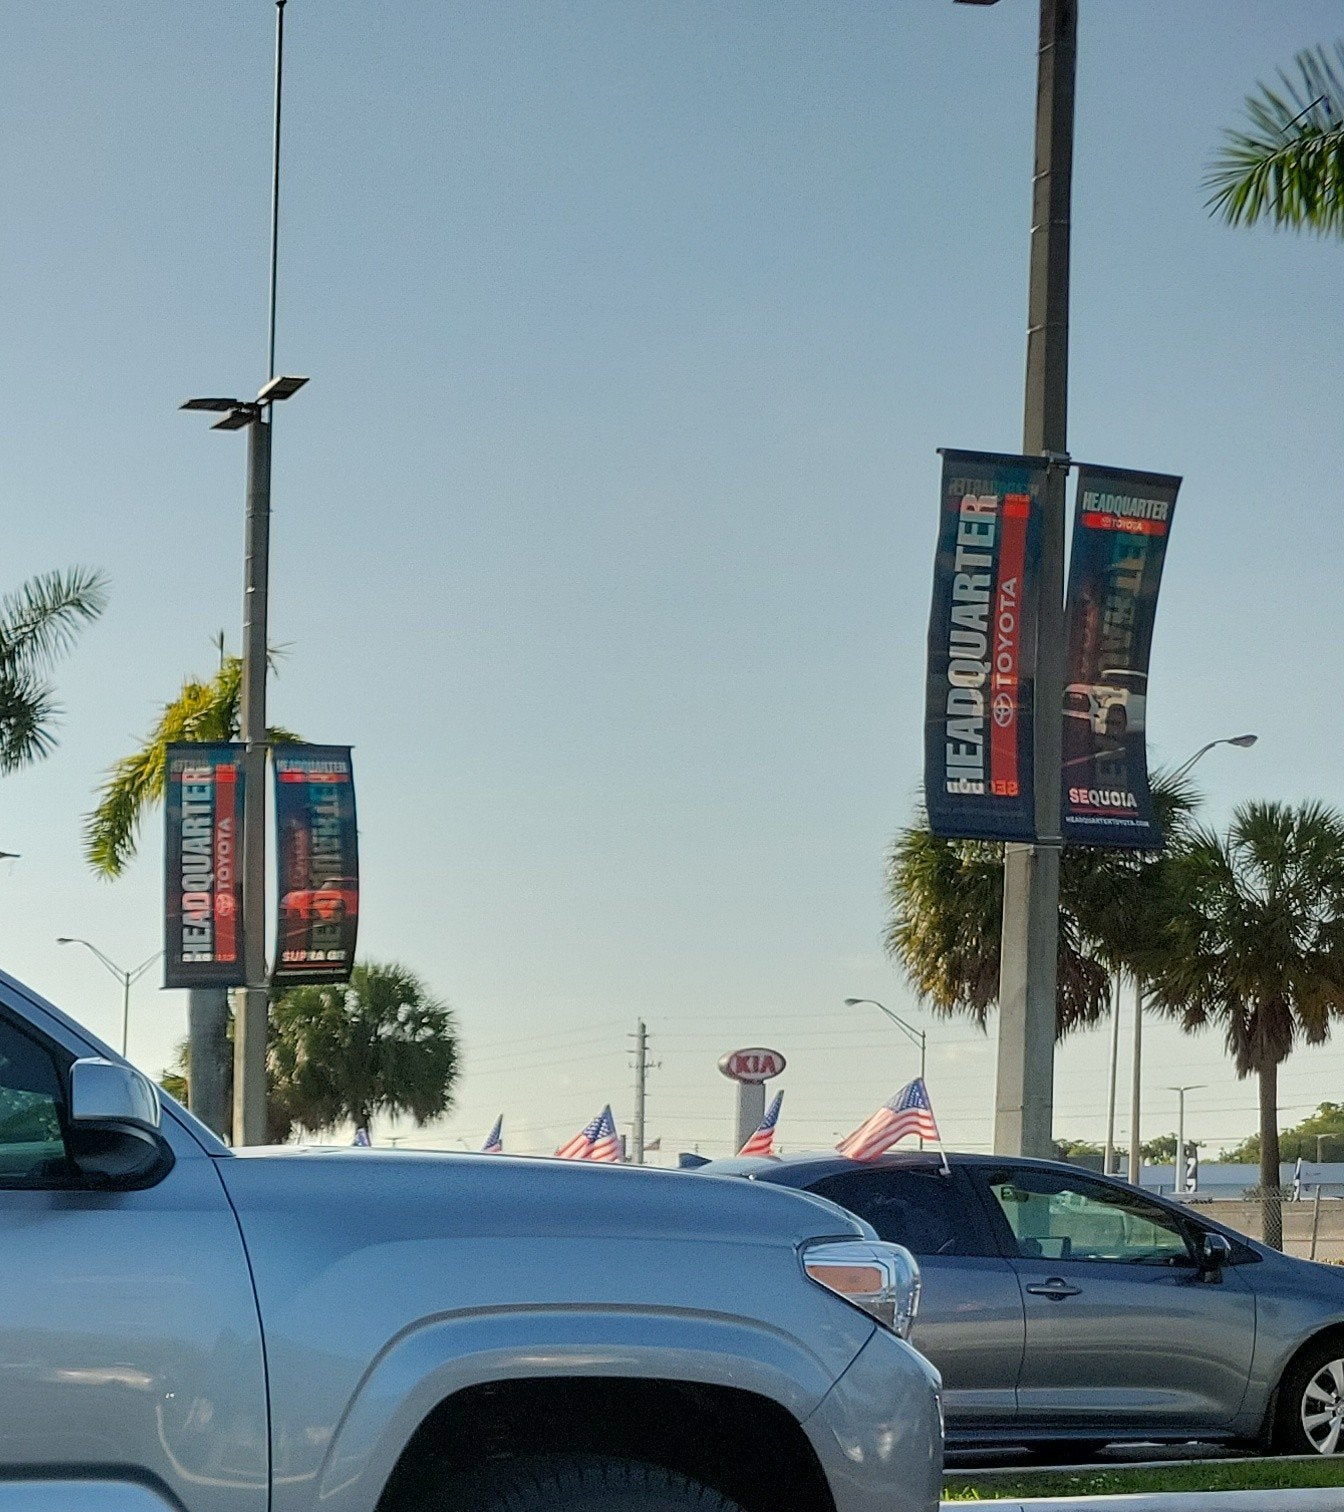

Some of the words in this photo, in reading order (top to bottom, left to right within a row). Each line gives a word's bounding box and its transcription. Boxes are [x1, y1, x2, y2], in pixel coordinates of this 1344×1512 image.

[1082, 491, 1169, 520] HEADQUARTER
[946, 494, 998, 795] HEADQUARTER
[994, 577, 1017, 686] TOYOTA
[1069, 787, 1138, 808] SEQUOIA
[182, 768, 214, 962] HEADQUARTER
[217, 817, 232, 890] TOYOTA
[736, 1054, 777, 1074] KIA
